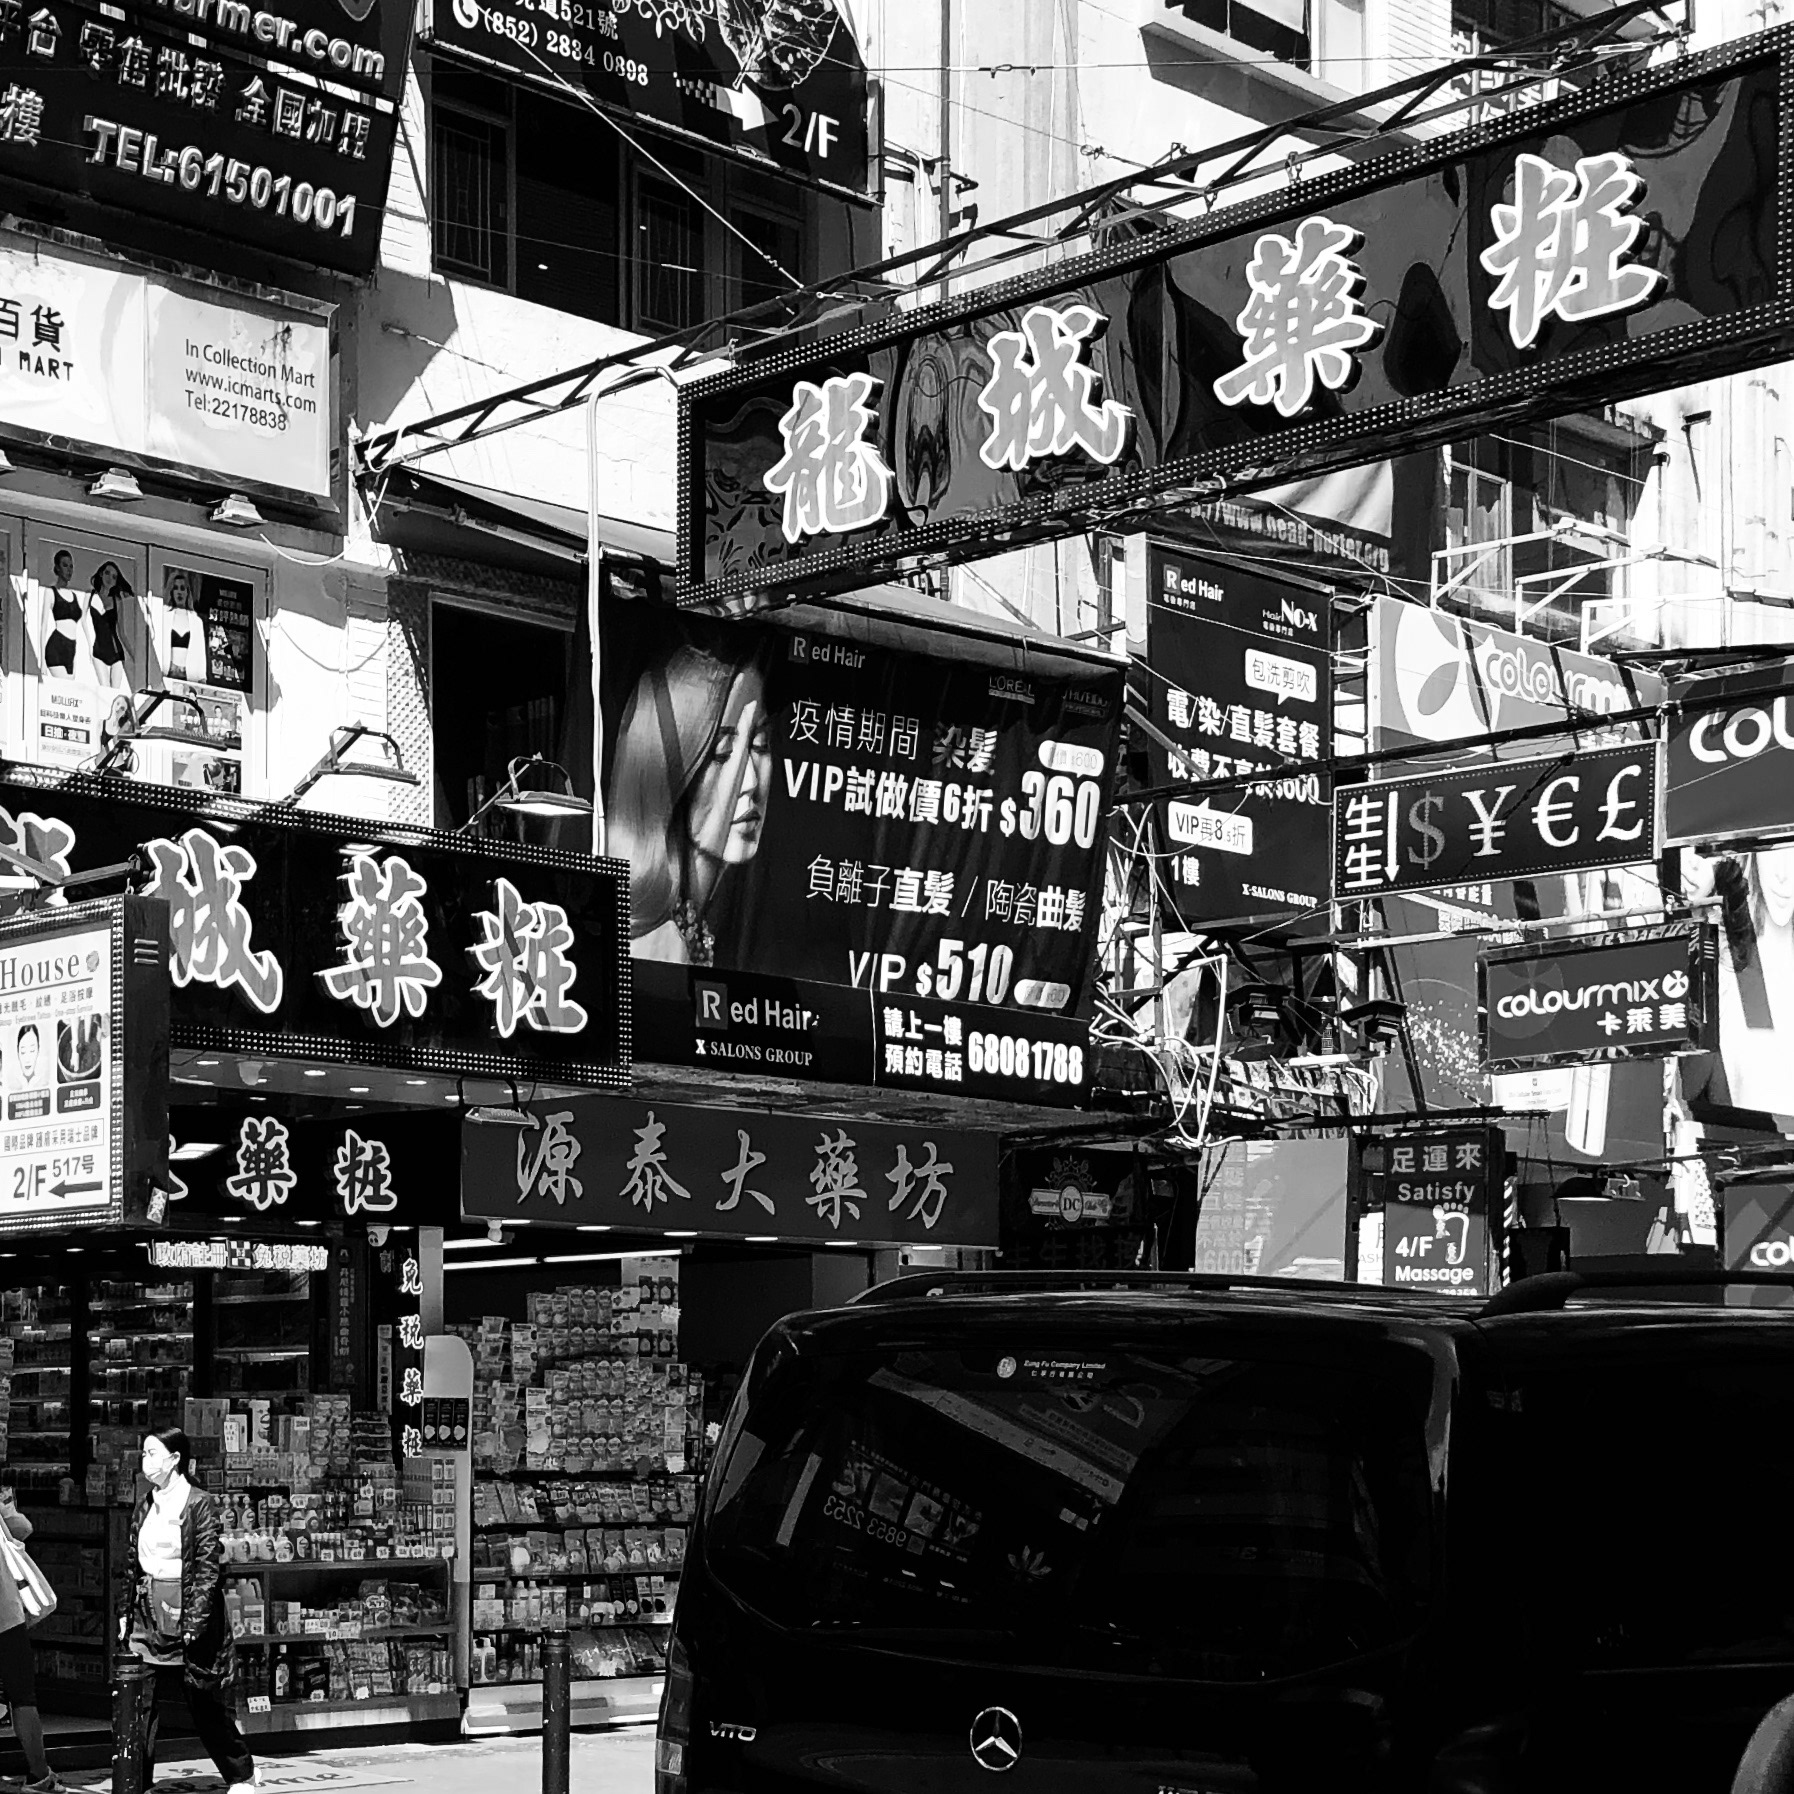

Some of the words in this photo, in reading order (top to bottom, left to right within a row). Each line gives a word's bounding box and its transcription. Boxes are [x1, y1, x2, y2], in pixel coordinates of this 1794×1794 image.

[155, 0, 385, 81] armer.com
[484, 7, 538, 47] (852)
[546, 30, 595, 66] 2834
[603, 51, 649, 86] 0898
[781, 103, 840, 158] 2/F
[19, 350, 74, 381] MART
[186, 339, 199, 359] In
[203, 344, 277, 379] Collection
[281, 365, 316, 389] Mart
[185, 368, 317, 414] www.icmarts.com
[185, 389, 288, 431] Tel:22178838
[1166, 570, 1197, 595] Red
[1198, 579, 1224, 602] Hair
[834, 647, 866, 669] Hair
[1252, 657, 1311, 695] 包洗剪吹
[789, 696, 920, 760] 疫情期間
[783, 758, 995, 833] VIP試做價6折
[1000, 770, 1101, 849] $360
[1171, 855, 1200, 887] 1樓
[805, 853, 955, 917] 負離子直髮
[985, 879, 1087, 933] 陶瓷曲髮
[1242, 883, 1286, 903] X-SALONS
[1286, 892, 1318, 909] GROUP
[0, 954, 80, 991] House
[848, 949, 906, 993] VIP
[915, 938, 1014, 1006] $510
[701, 989, 758, 1026] Red
[764, 999, 812, 1031] Hair
[1497, 977, 1661, 1019] colourmix
[882, 1006, 963, 1047] 請上一樓
[1596, 1002, 1687, 1036] 卡萊美
[696, 1038, 762, 1062] X-SALONS
[765, 1048, 813, 1068] GROUP
[884, 1043, 963, 1083] 預約電話
[968, 1031, 1084, 1086] 68081788
[515, 1110, 954, 1230] 源泰大藥坊
[1391, 1142, 1482, 1174] 足運來
[13, 1164, 48, 1201] 2/F
[1398, 1181, 1475, 1204] Satisfy
[1395, 1236, 1433, 1258] 4/F
[1395, 1265, 1475, 1285] Massage
[708, 1720, 758, 1743] VITO
